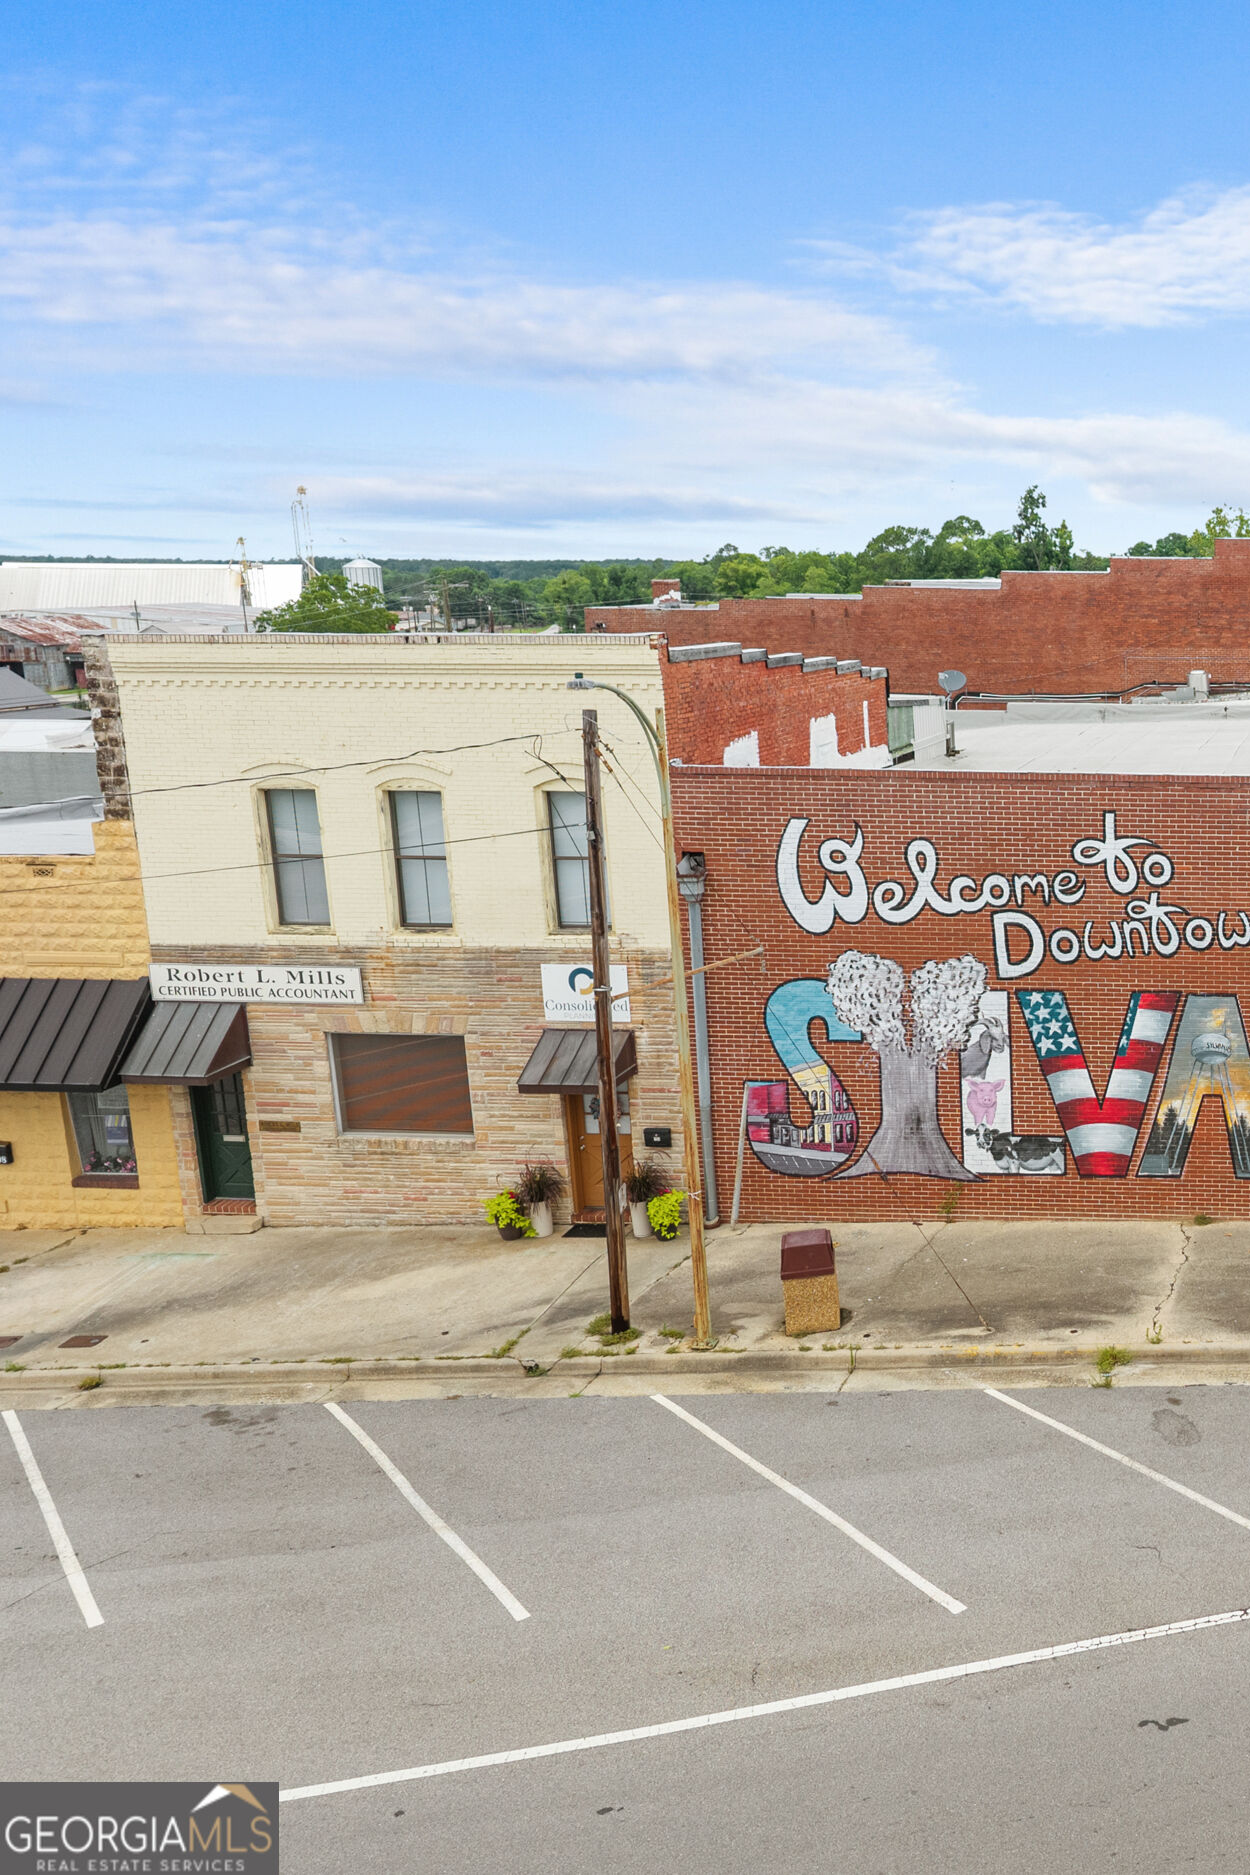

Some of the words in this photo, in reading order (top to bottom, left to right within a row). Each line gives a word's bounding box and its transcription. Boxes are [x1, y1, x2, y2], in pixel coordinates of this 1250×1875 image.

[776, 817, 1087, 936] Welcome
[1071, 811, 1175, 895] to
[166, 968, 245, 983] Robert
[256, 969, 276, 984] L.
[286, 970, 346, 985] Mills
[158, 985, 217, 997] CERTIFIED
[220, 987, 264, 997] PUBLIC
[268, 987, 356, 999] ACCOUNTANT
[545, 1000, 628, 1011] Consolied
